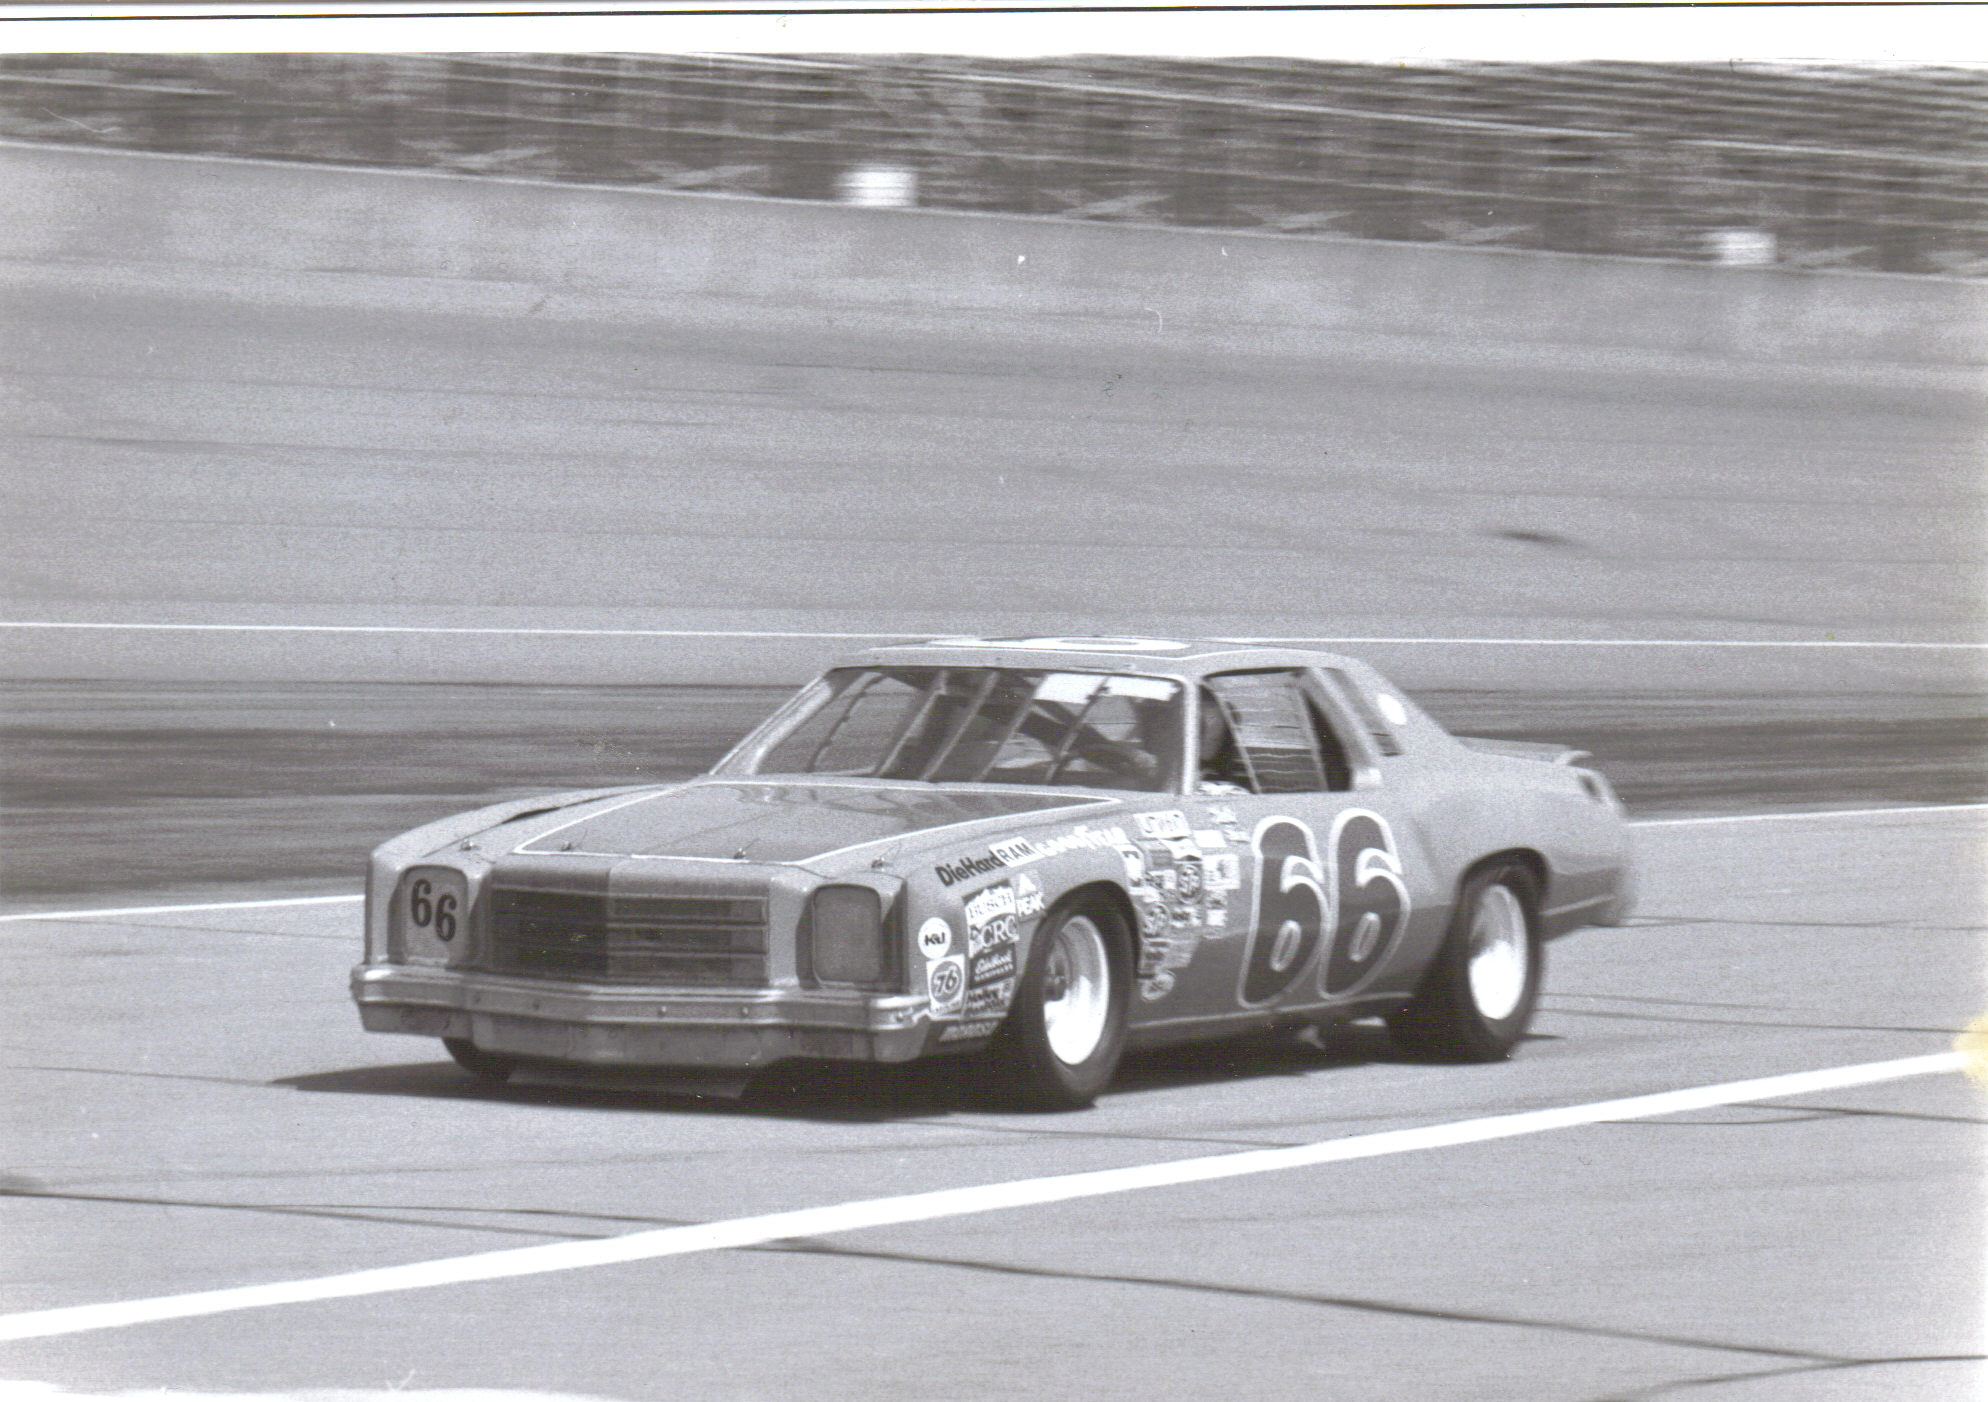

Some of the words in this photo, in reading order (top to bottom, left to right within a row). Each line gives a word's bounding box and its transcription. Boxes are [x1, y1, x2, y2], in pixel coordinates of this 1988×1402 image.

[935, 849, 1008, 887] DieHard
[996, 842, 1036, 862] RAM
[411, 878, 457, 942] 66
[1237, 808, 1411, 1009] 66
[933, 964, 960, 997] 76
